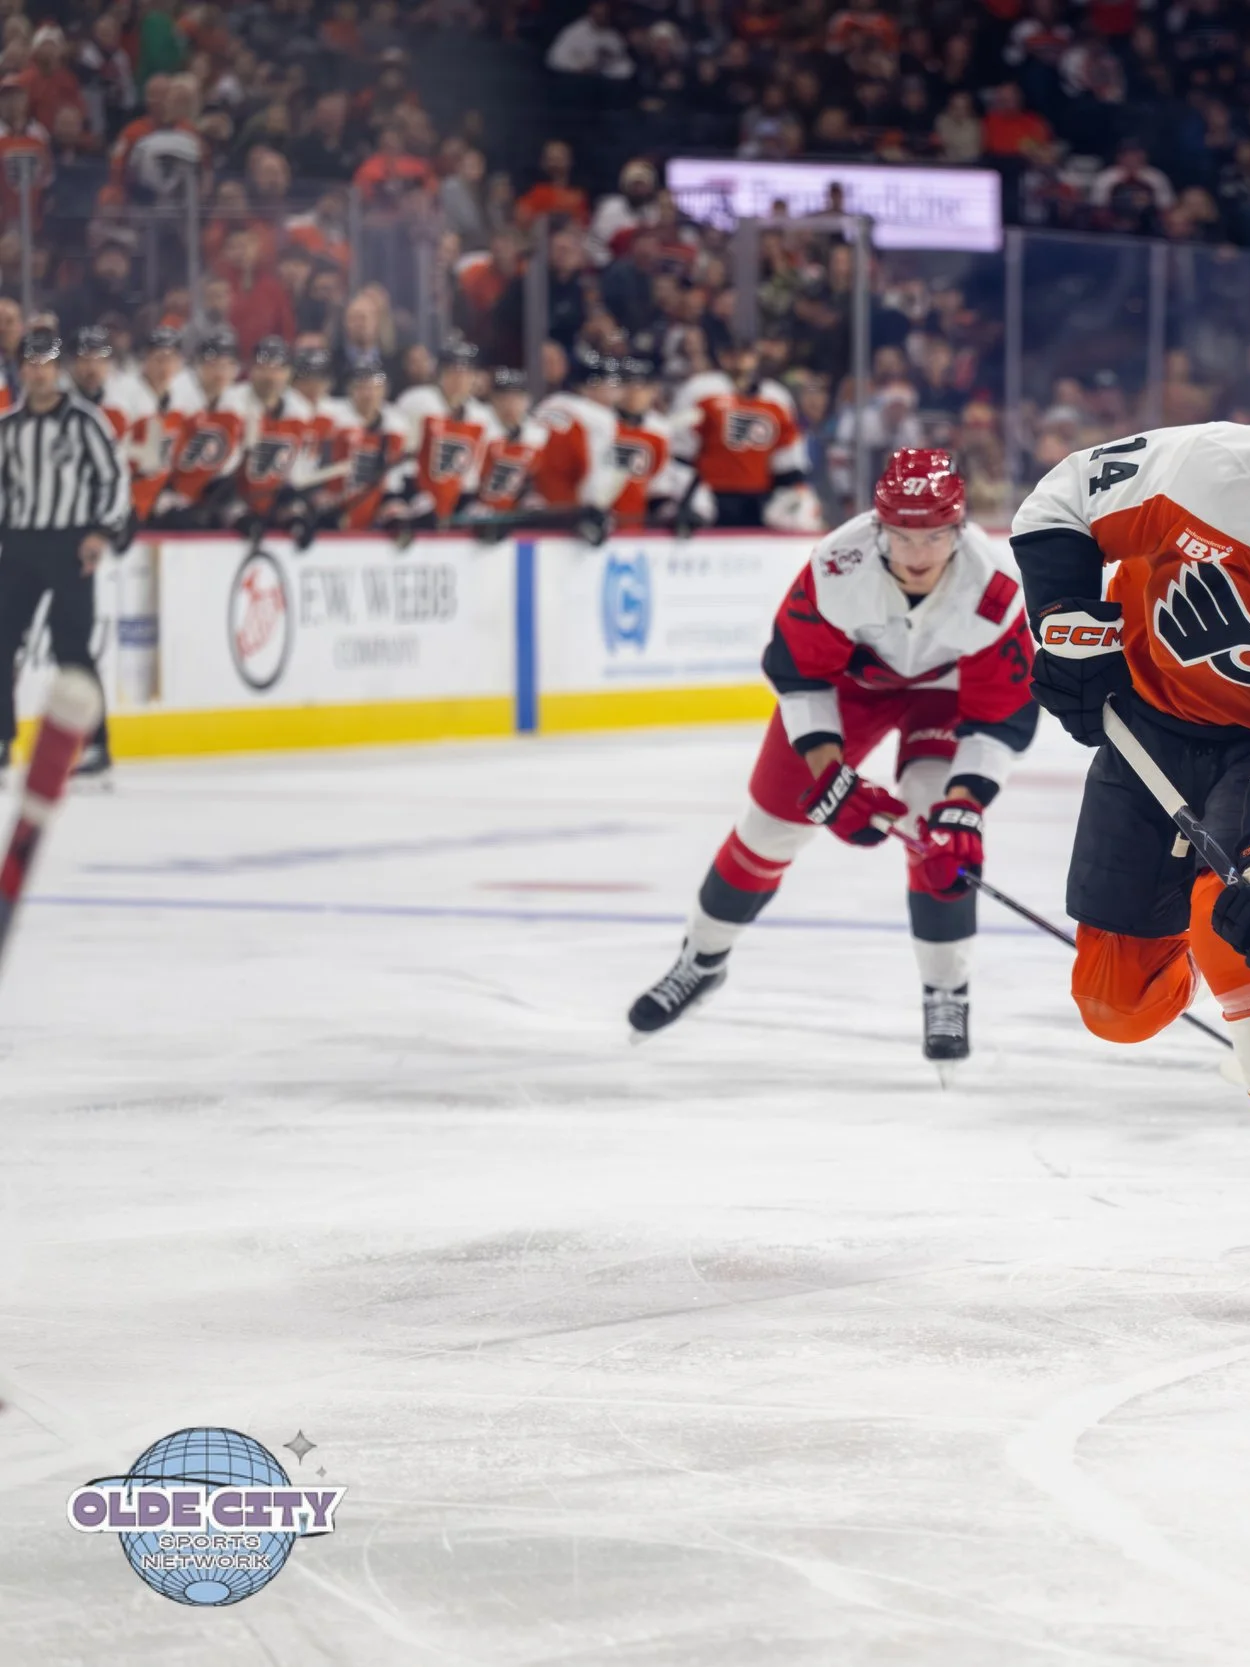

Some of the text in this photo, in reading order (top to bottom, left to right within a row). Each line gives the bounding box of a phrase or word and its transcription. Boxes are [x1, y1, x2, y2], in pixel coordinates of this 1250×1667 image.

[1089, 437, 1147, 497] 14
[903, 477, 928, 496] 37
[1175, 531, 1231, 563] IBX
[361, 562, 458, 625] WEBB
[1044, 625, 1124, 647] CCM
